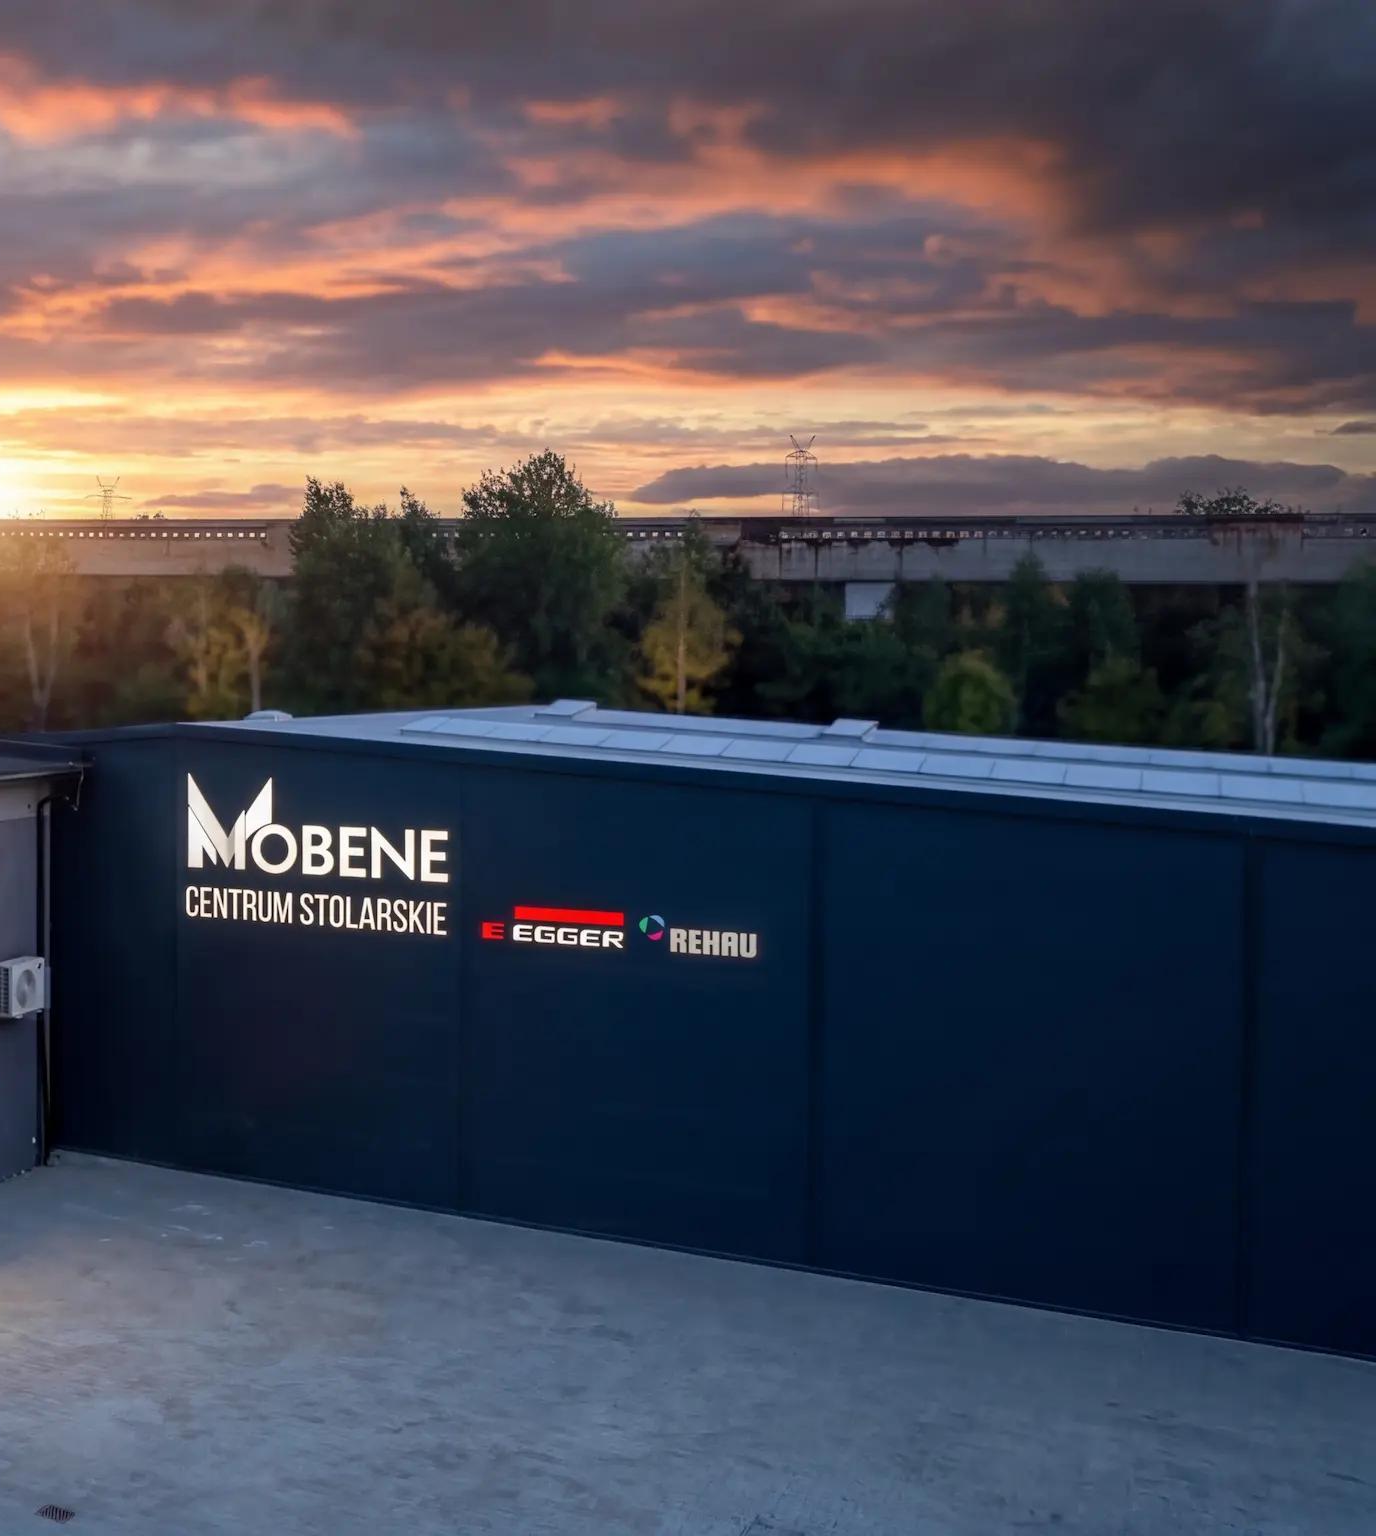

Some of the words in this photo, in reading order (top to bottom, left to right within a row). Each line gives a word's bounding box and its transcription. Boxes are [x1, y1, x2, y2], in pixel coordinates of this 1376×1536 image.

[187, 772, 449, 883] MOBENE
[185, 885, 293, 924] CENTRUM
[299, 892, 448, 936] STOLARSKIE
[512, 924, 624, 949] EGGER
[669, 927, 758, 958] REHAU
